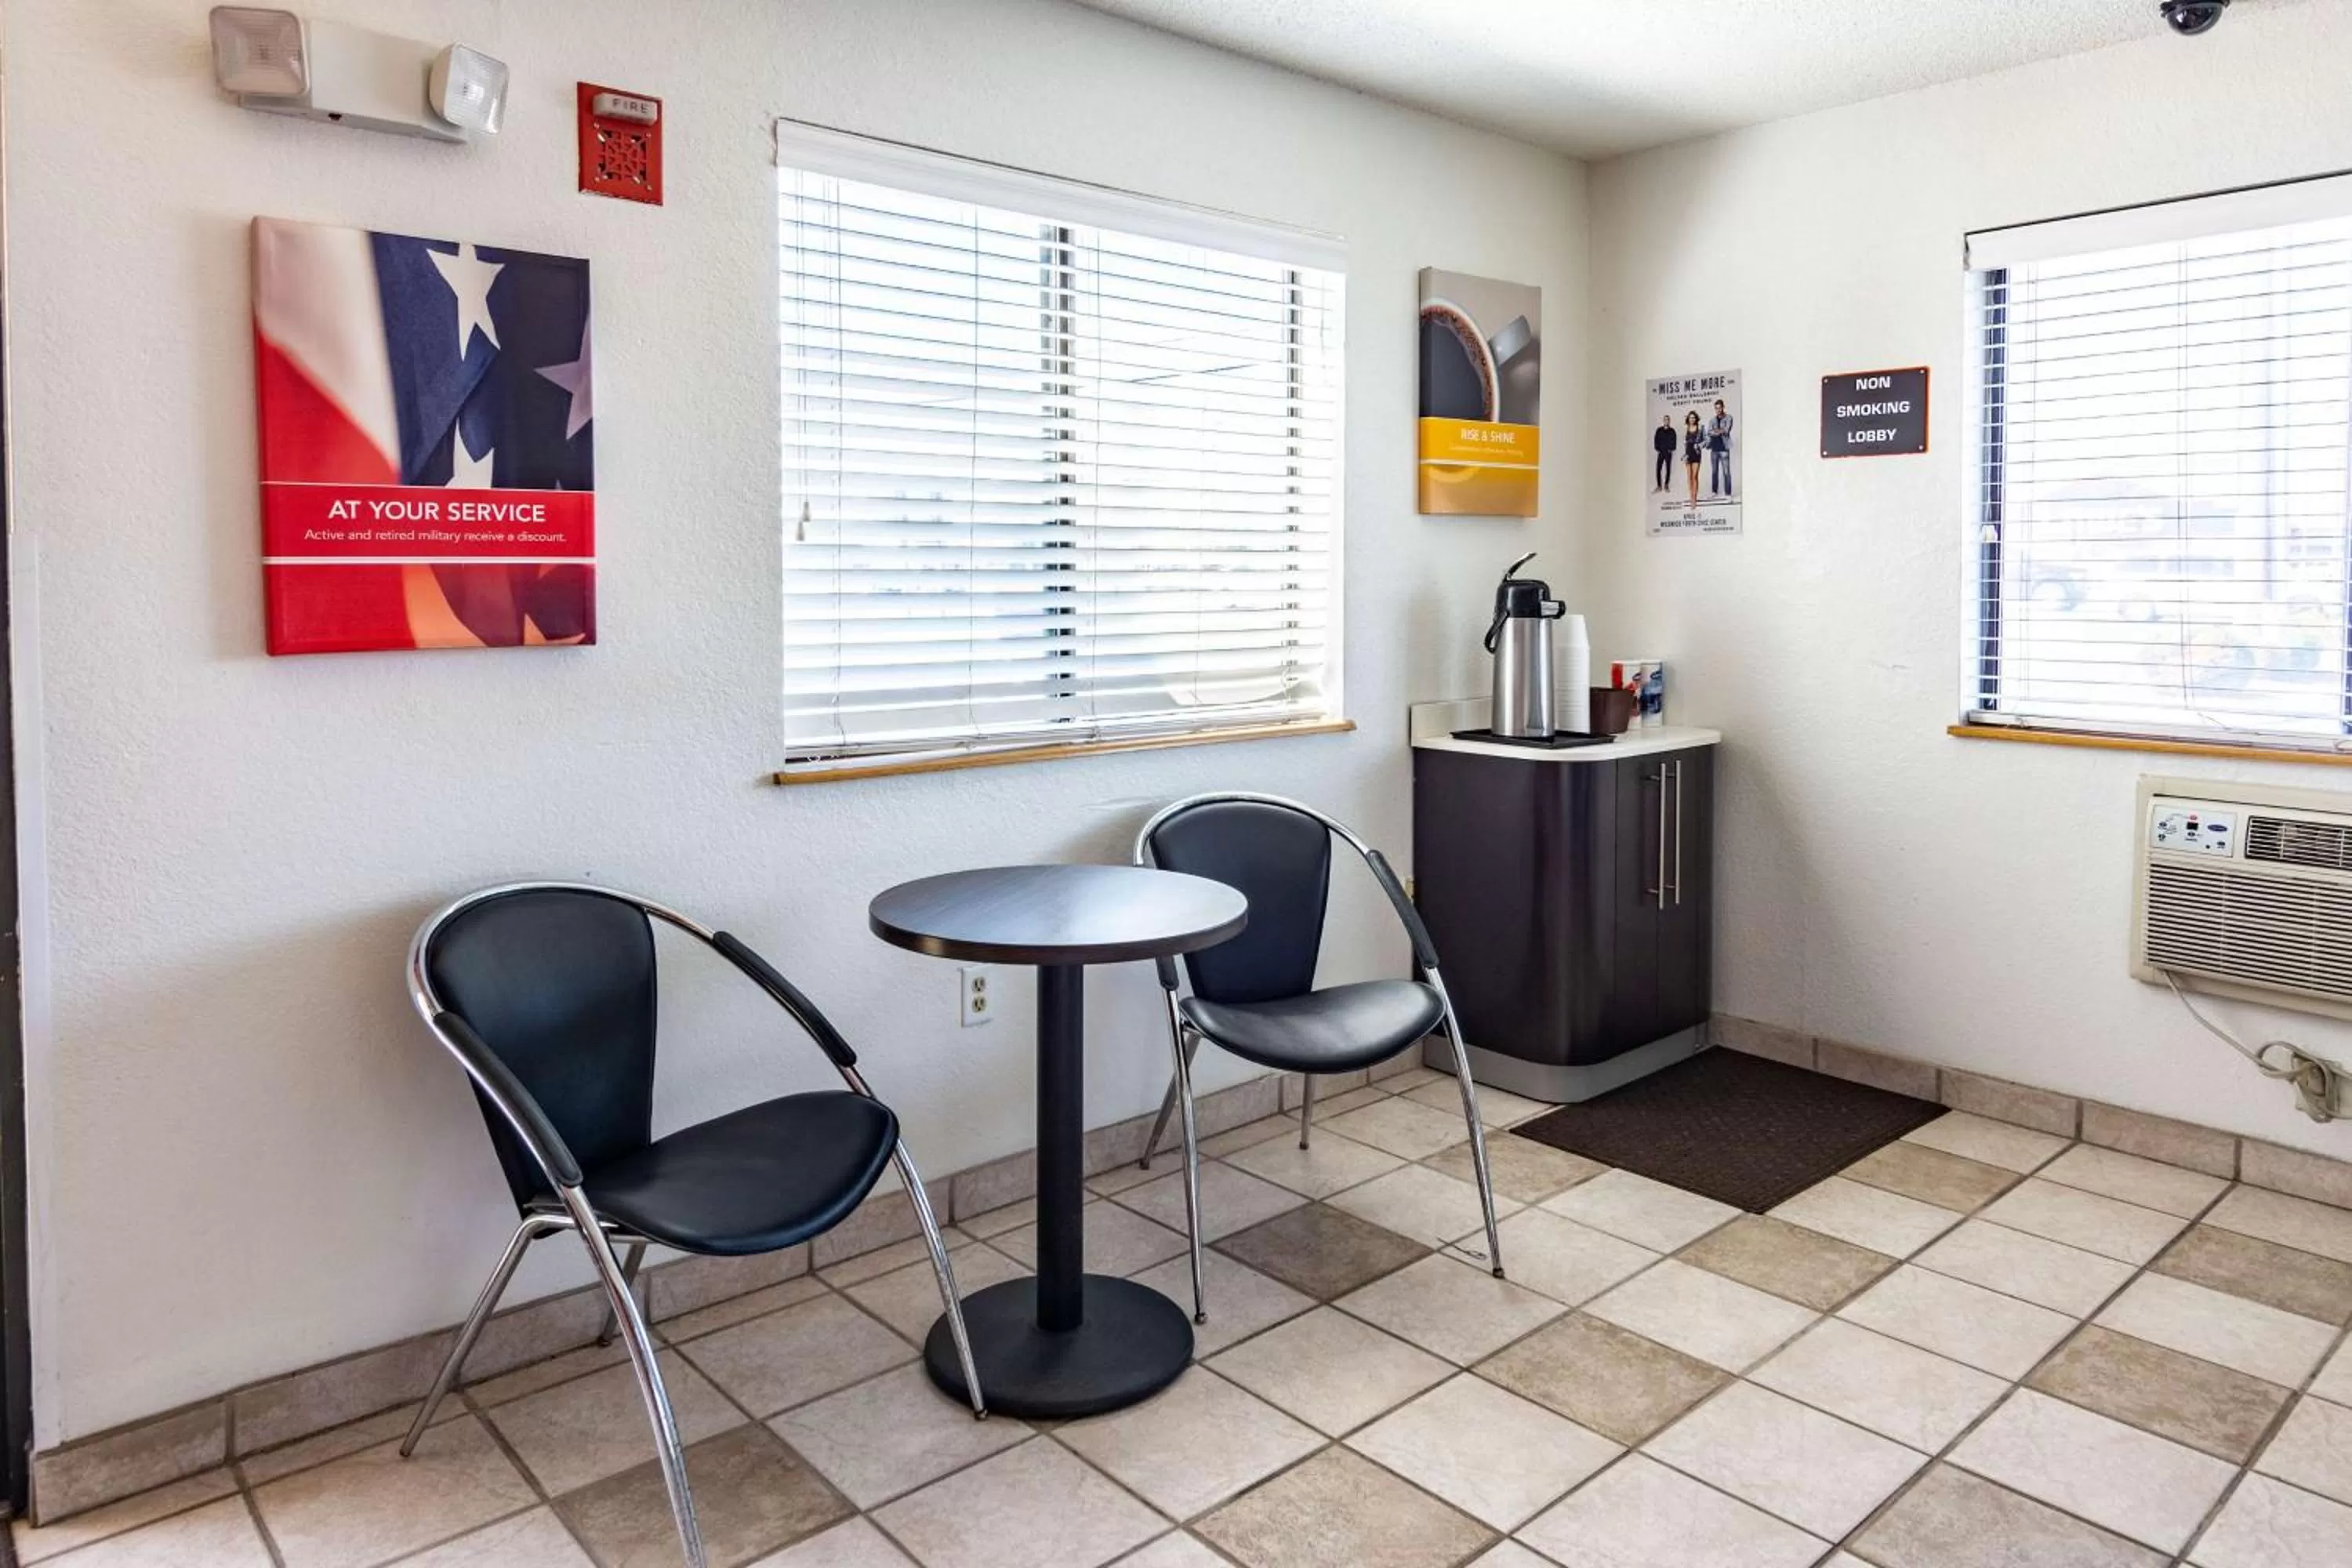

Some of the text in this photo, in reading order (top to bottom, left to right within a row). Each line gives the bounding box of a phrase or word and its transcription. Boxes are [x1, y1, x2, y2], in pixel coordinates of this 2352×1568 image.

[612, 98, 648, 114] FIRE
[1658, 376, 1726, 394] MISS ME MORE
[1856, 376, 1891, 390] NON
[1836, 401, 1911, 418] SMOKING
[1461, 428, 1515, 444] RISE & SHINE
[1847, 428, 1897, 443] LOBBY
[328, 499, 546, 522] AT YOUR SERVICE
[304, 528, 344, 540] Active
[347, 529, 372, 540] and
[376, 529, 415, 541] retired
[418, 530, 462, 543] military
[463, 531, 505, 542] receive
[517, 531, 567, 543] discount.
